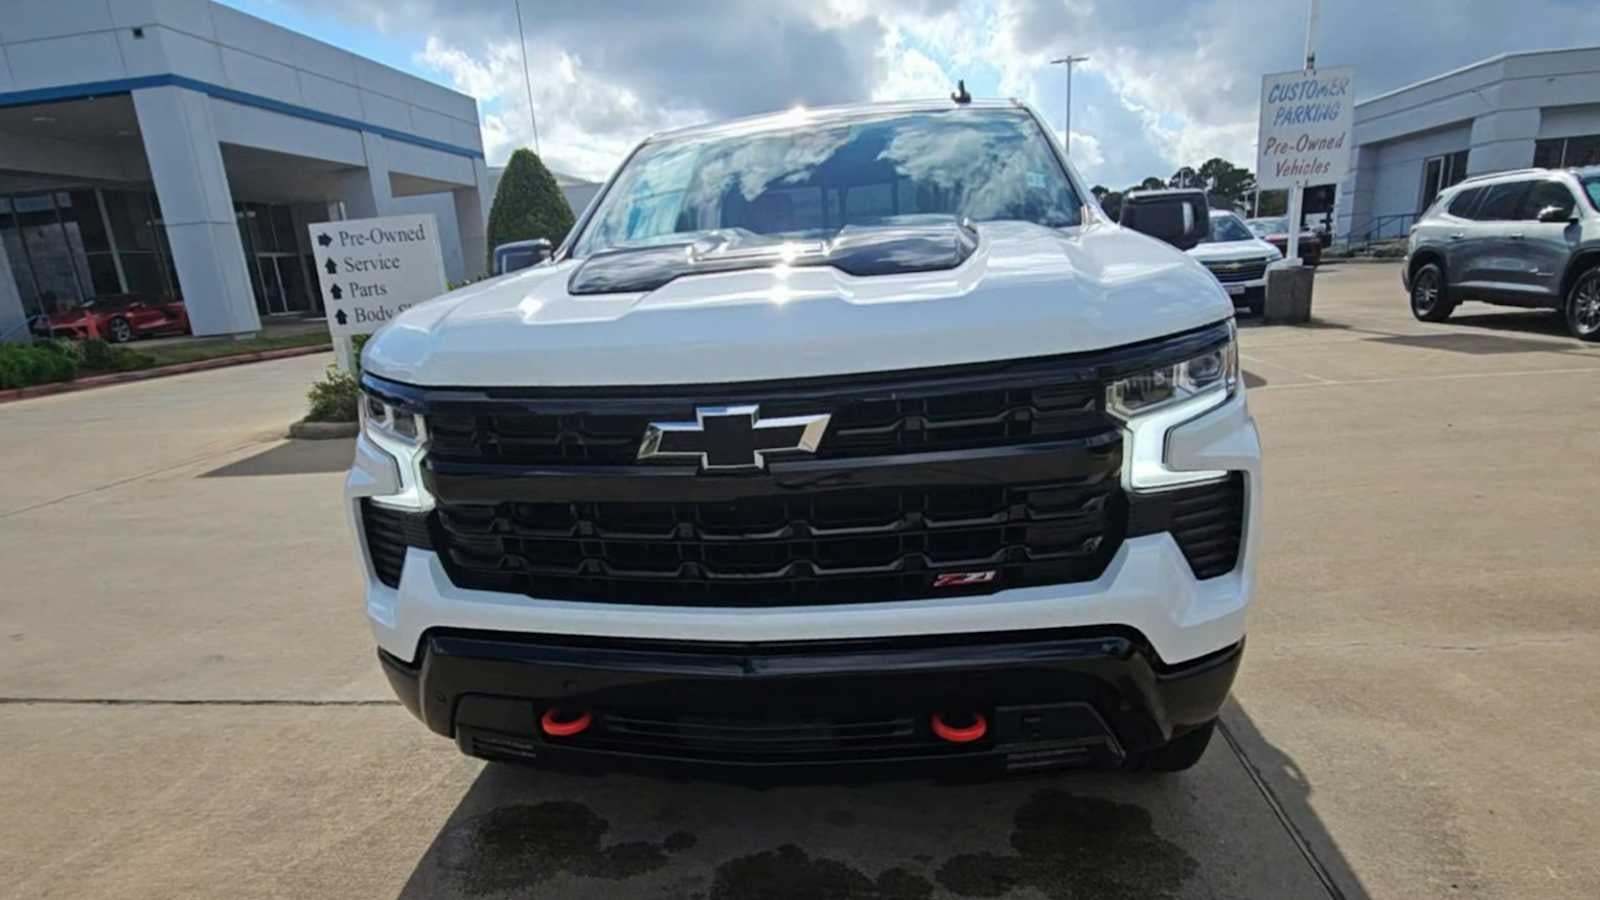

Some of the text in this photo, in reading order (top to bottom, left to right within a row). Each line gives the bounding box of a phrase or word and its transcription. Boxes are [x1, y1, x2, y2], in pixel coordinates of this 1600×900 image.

[1273, 102, 1341, 127] PARKING
[1264, 131, 1346, 156] Pre-Owned
[1275, 157, 1331, 178] Vehicles
[339, 224, 426, 247] Pre-Owned
[343, 253, 401, 273] Service
[349, 282, 388, 298] Parts
